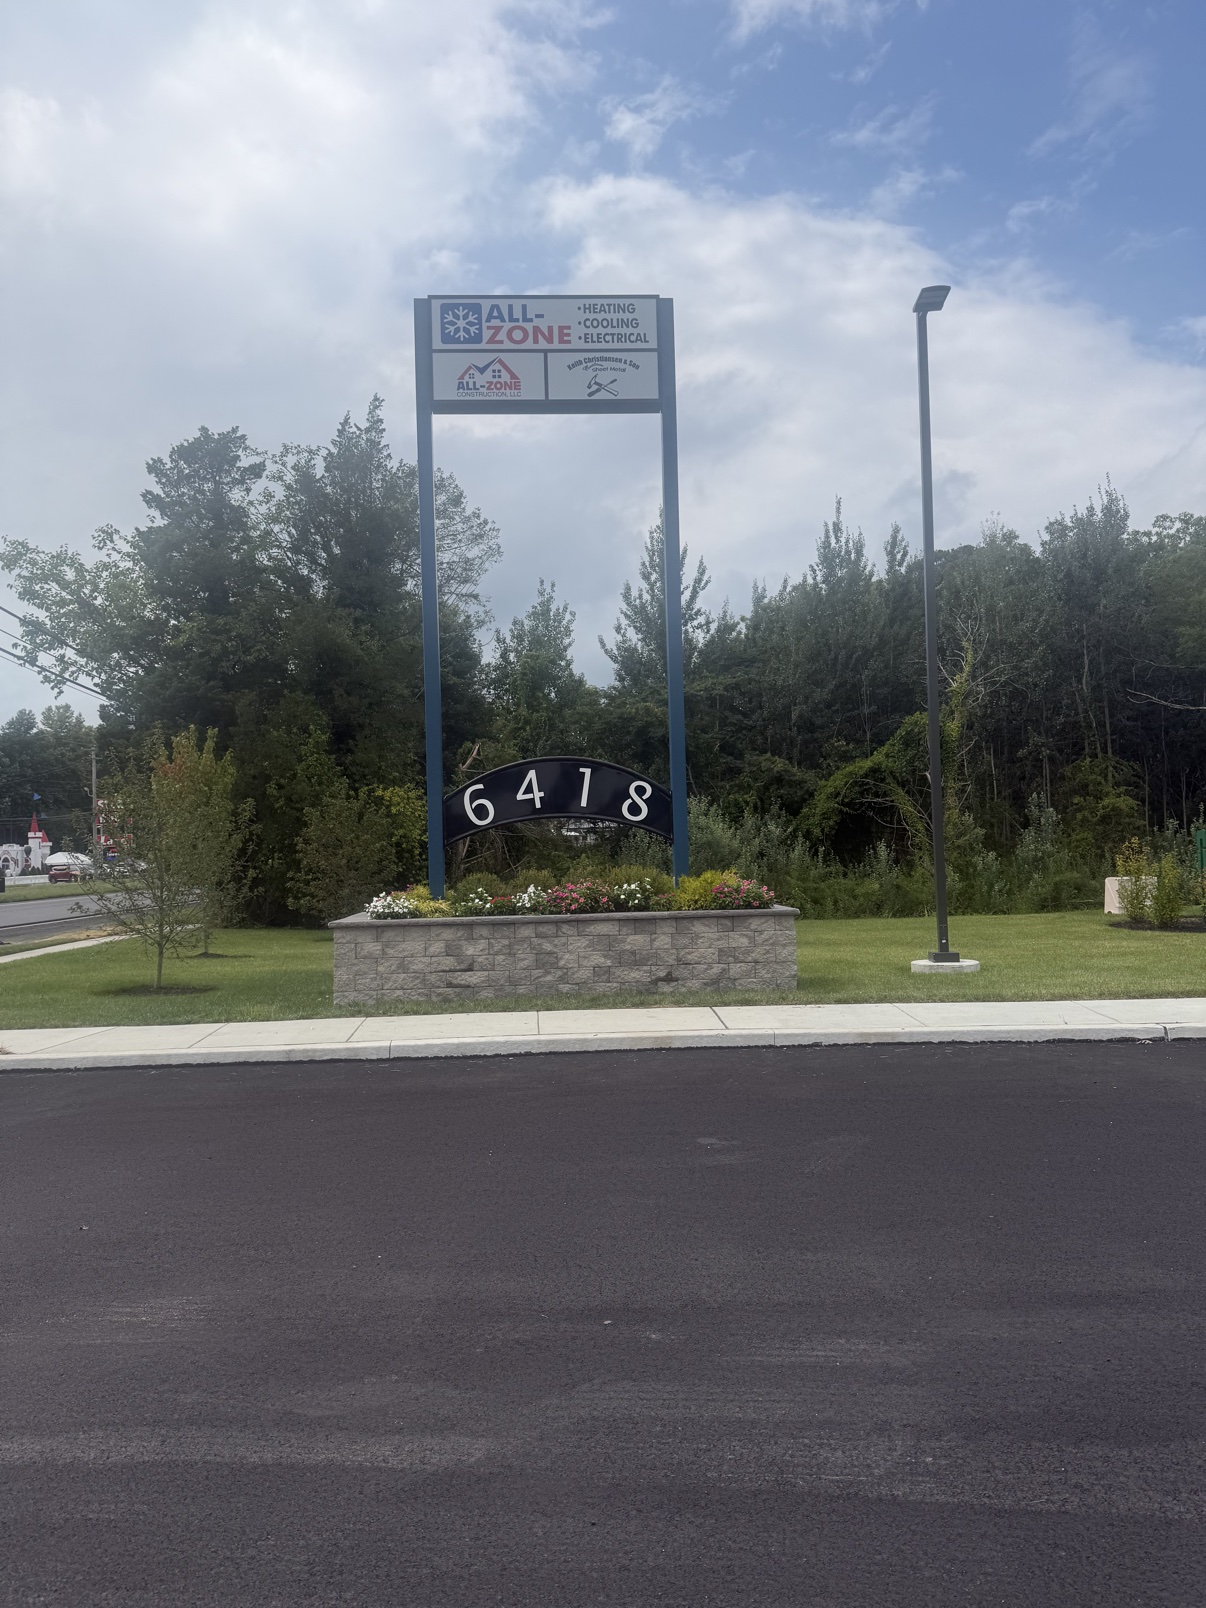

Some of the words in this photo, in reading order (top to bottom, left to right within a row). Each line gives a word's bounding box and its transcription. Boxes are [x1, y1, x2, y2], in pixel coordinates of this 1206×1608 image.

[485, 304, 544, 323] ALL-
[583, 303, 636, 314] HEATING
[583, 318, 639, 329] COOLING
[485, 325, 572, 344] ZONE
[583, 332, 650, 344] ELECTRICAL
[566, 359, 584, 371] Keith
[583, 356, 623, 364] Christiansen
[628, 360, 640, 371] Son
[457, 381, 521, 391] ALL-ZONE
